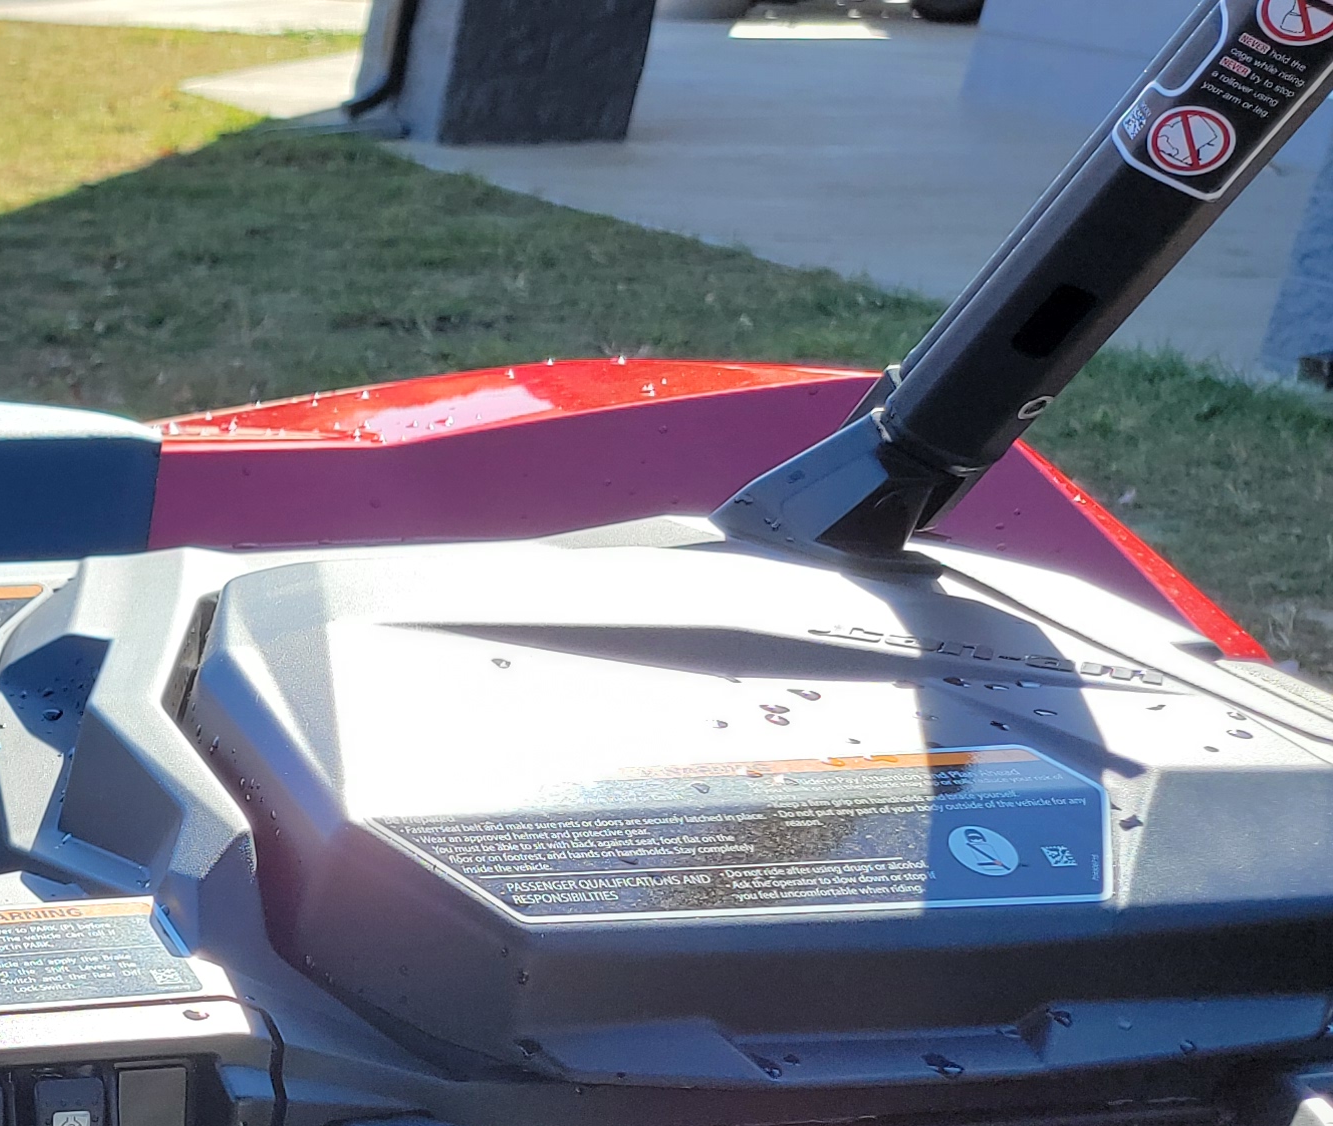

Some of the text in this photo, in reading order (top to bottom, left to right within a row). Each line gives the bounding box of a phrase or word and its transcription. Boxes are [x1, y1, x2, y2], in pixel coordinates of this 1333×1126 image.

[1231, 48, 1253, 63] cage
[1254, 59, 1278, 74] while
[1241, 35, 1307, 72] NEVER hold the
[1221, 58, 1295, 98] NEVER try to stop
[1201, 81, 1223, 95] your
[1222, 92, 1241, 104] arm
[1241, 101, 1253, 109] or
[1219, 74, 1253, 93] rollover
[1253, 93, 1279, 107] using
[725, 869, 742, 877] Do
[743, 868, 763, 876] not
[763, 867, 785, 875] ride
[786, 866, 811, 874] after
[812, 864, 841, 875] using
[843, 863, 874, 873] drugs
[887, 860, 929, 869] alcohol.
[506, 874, 711, 892] PASSENGER QUALIFICATIONS AND
[732, 880, 751, 888] Ask
[752, 879, 771, 887] the
[772, 876, 817, 888] operator
[831, 874, 857, 883] slow
[858, 873, 889, 881] down
[903, 871, 927, 881] stop
[512, 891, 619, 903] RESPONSIBILITIES
[735, 892, 757, 901] you
[758, 889, 779, 898] feel
[780, 886, 858, 897] uncomfortable
[859, 884, 890, 893] when
[30, 924, 57, 932] PARK
[78, 920, 111, 929] before
